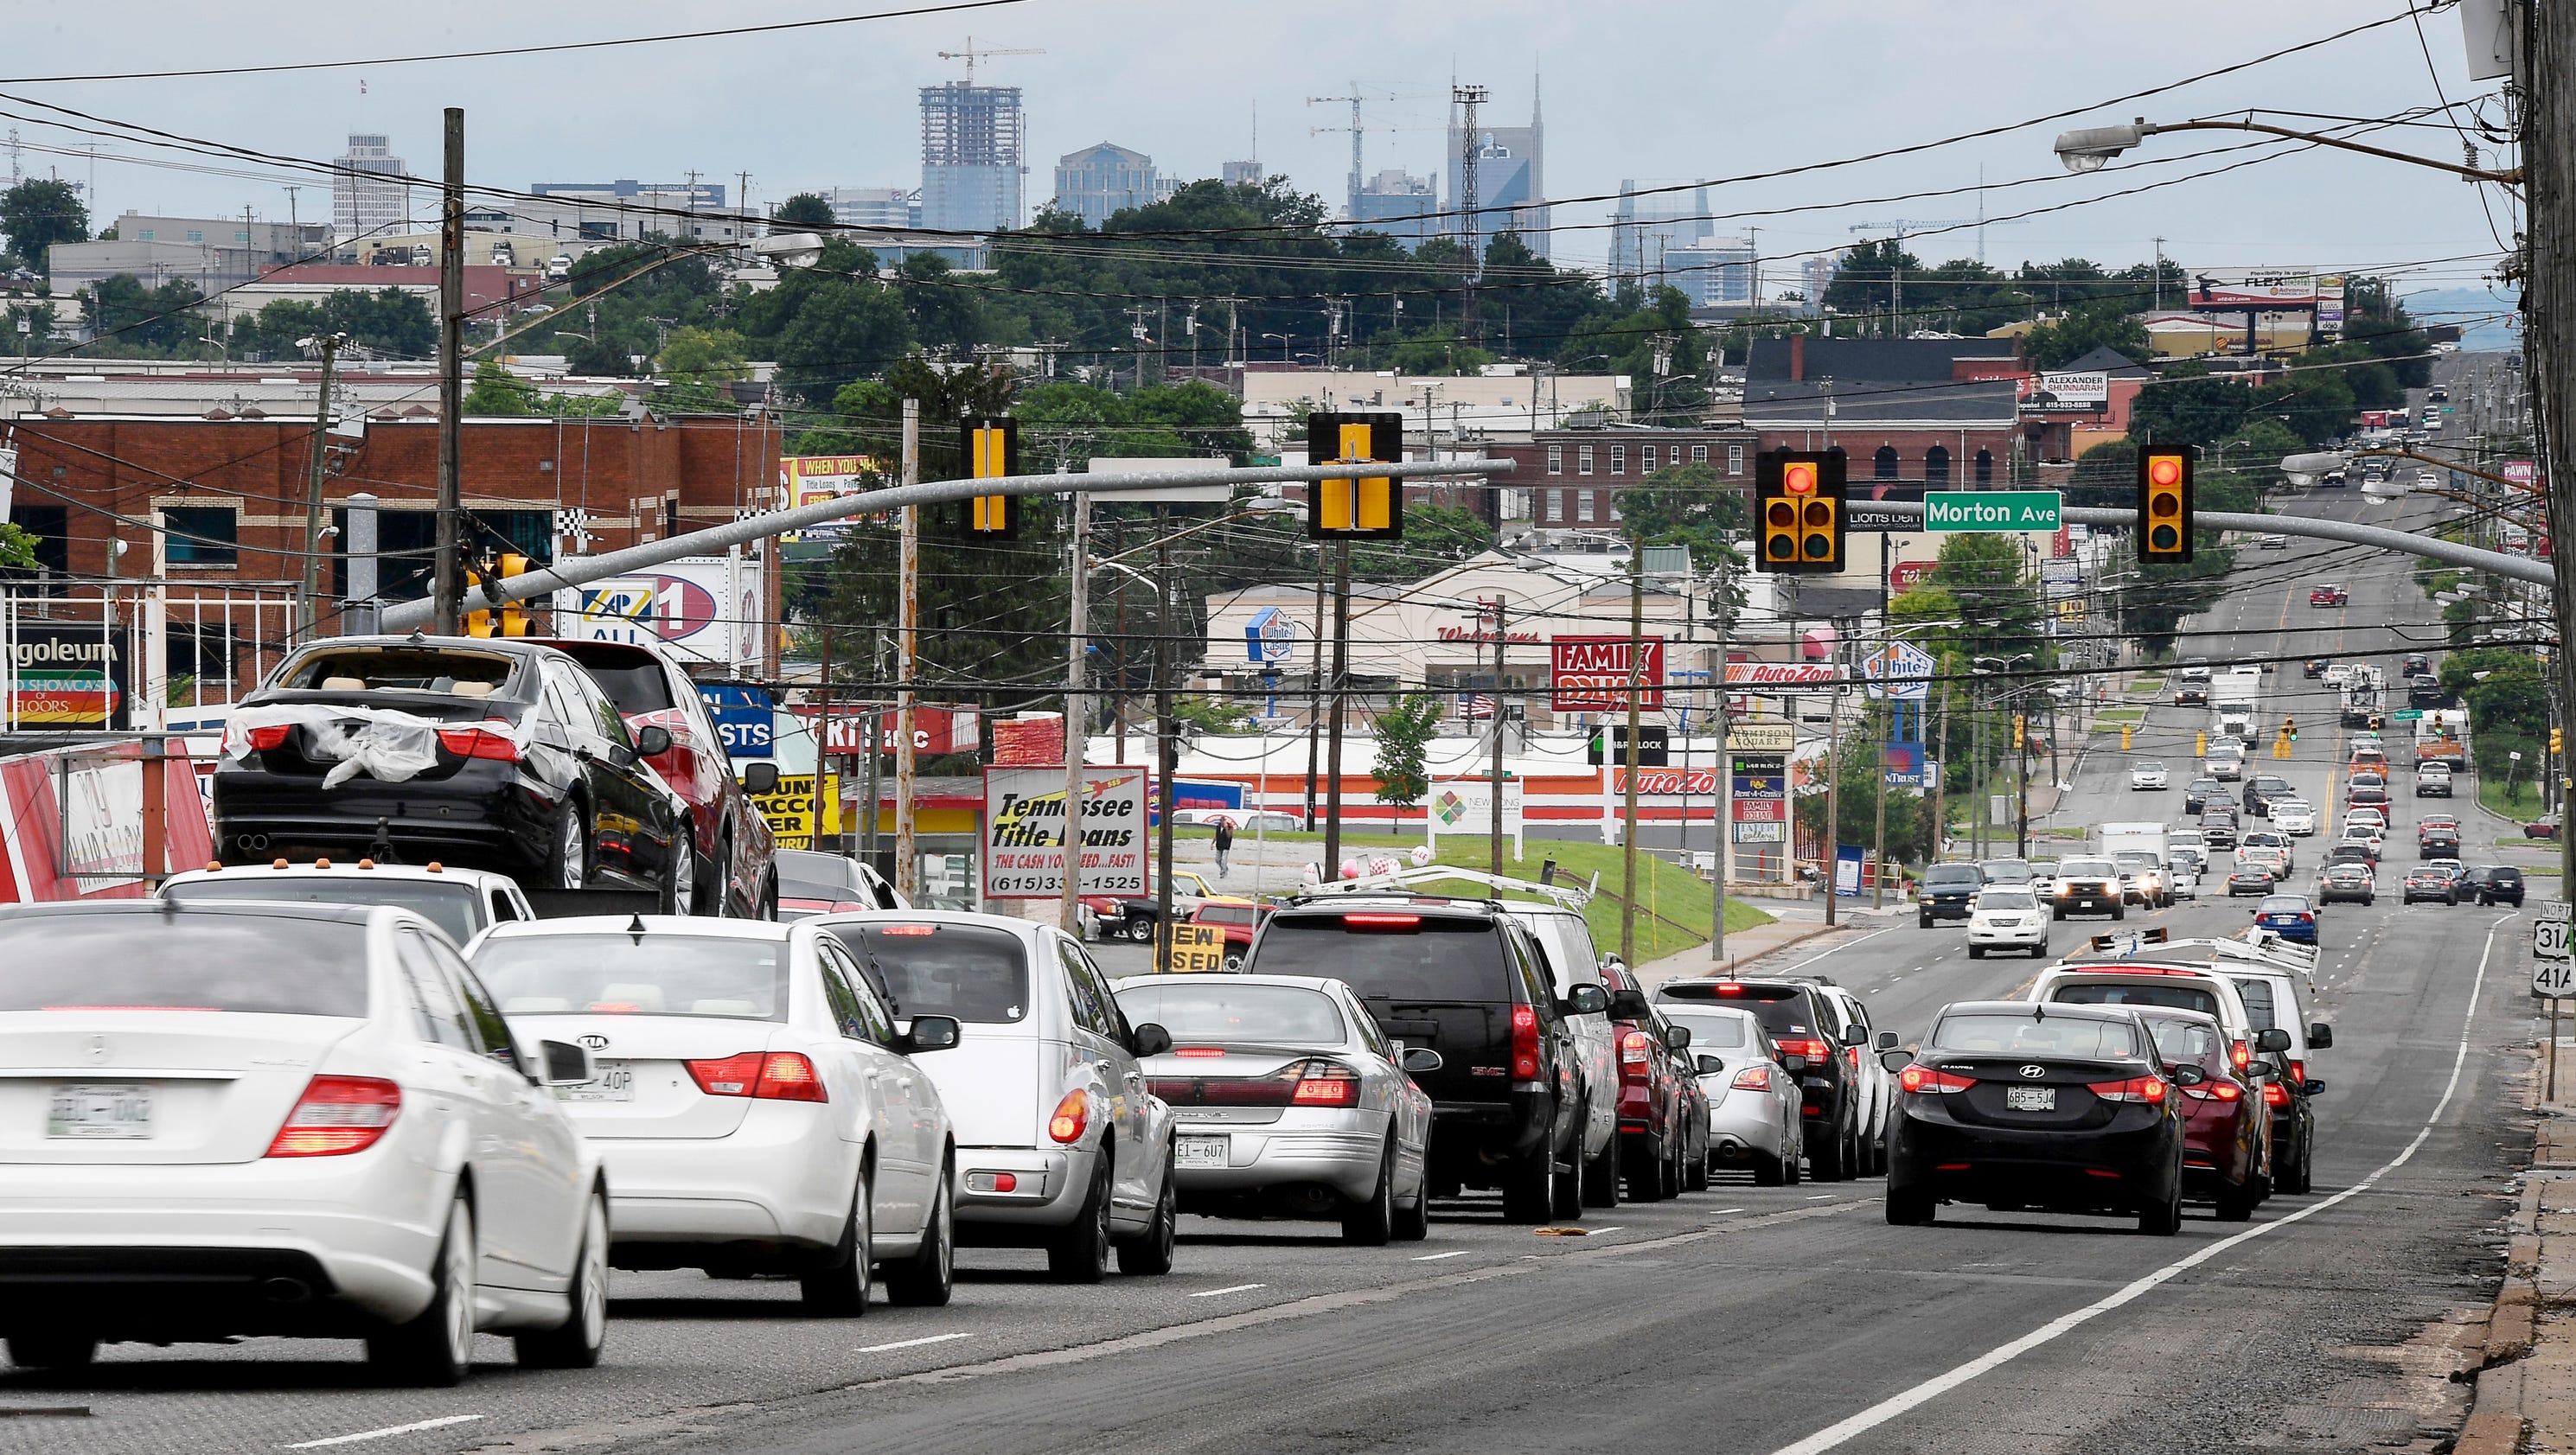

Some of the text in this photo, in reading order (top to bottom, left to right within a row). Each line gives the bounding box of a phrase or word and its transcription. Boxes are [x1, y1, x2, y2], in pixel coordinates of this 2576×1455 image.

[805, 460, 834, 475] WHEN
[837, 458, 857, 473] YOU
[2504, 465, 2532, 477] PAWN
[806, 480, 818, 489] Title
[819, 480, 836, 490] Loans
[1929, 502, 2055, 523] Morton Ave
[1265, 626, 1289, 640] White
[1750, 665, 1844, 682] AutoZon
[35, 692, 47, 700] OF
[1638, 741, 1662, 750] LOCK
[1735, 737, 1780, 747] SQUARE
[1469, 797, 1491, 807] NEW
[1743, 801, 1774, 811] FAMILY
[992, 821, 1050, 847] Title
[995, 853, 1013, 869] THE
[1017, 853, 1045, 869] CASH
[1471, 1066, 1506, 1076] GMC
